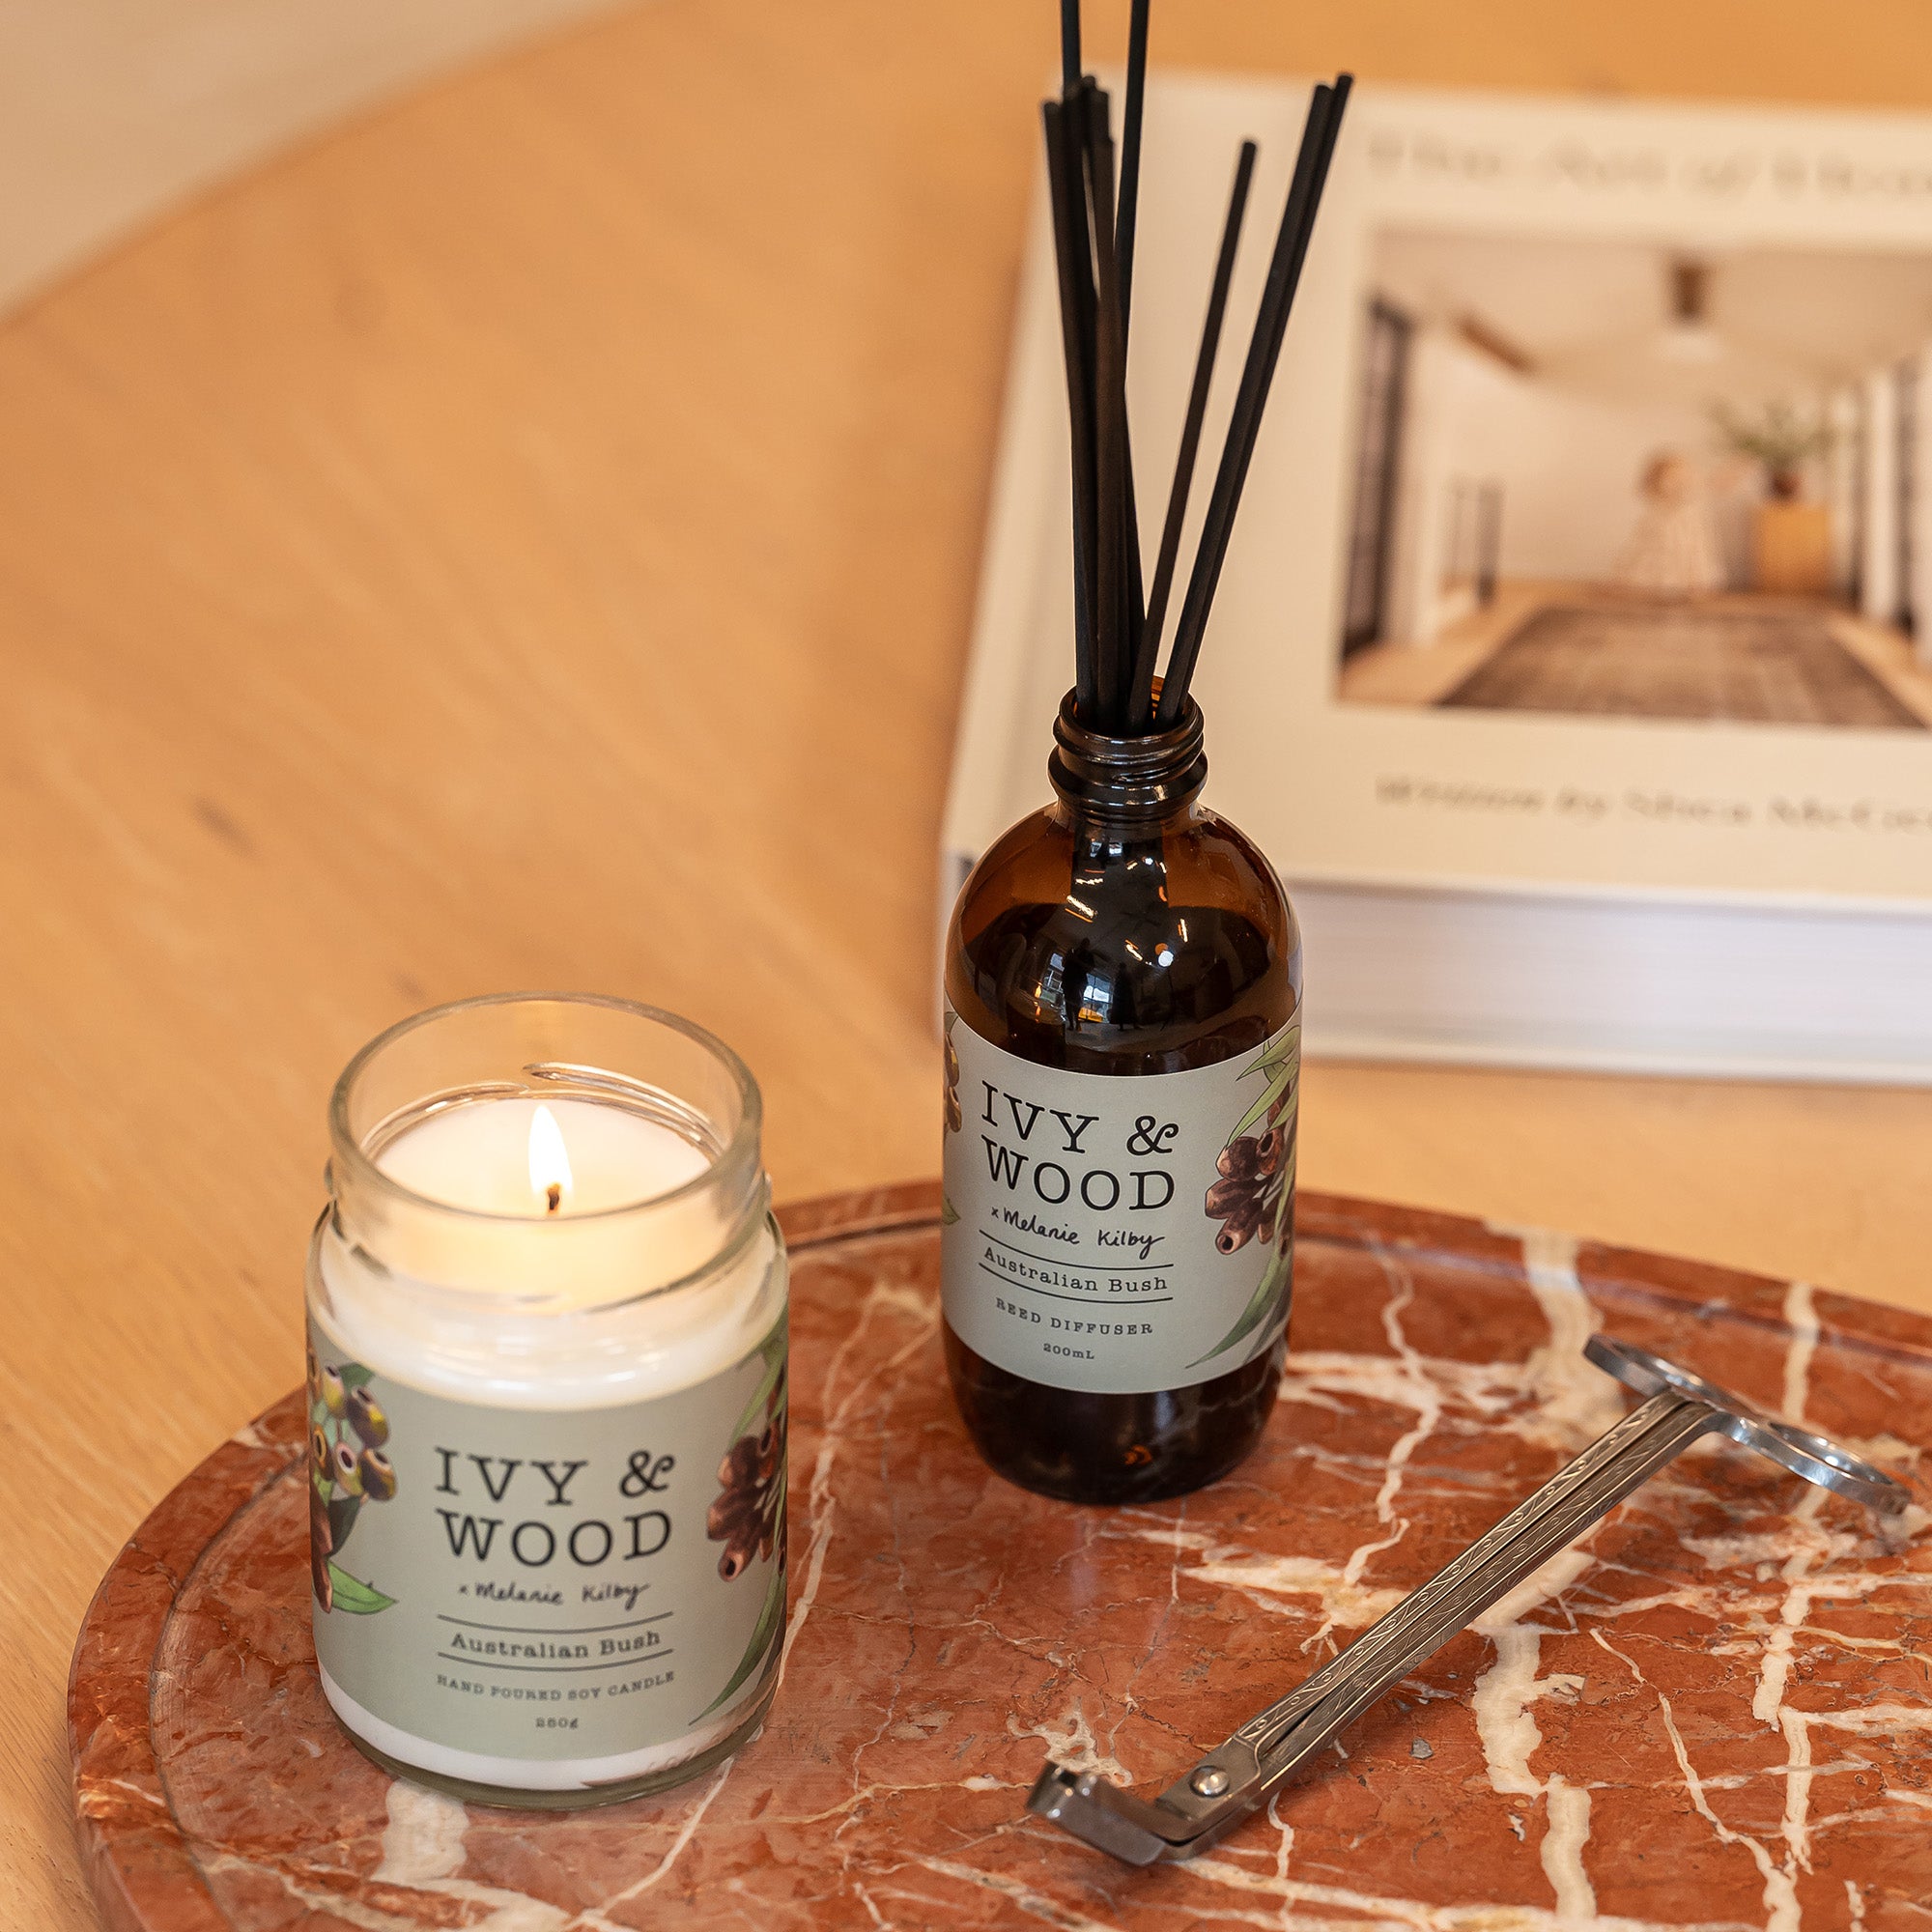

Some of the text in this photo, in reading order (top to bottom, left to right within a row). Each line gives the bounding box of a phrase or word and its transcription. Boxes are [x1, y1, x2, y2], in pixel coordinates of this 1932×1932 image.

[980, 1080, 1179, 1156] IVY &
[980, 1134, 1176, 1211] WOOD
[1003, 1208, 1080, 1245] Melanie
[1097, 1229, 1165, 1260] Kilby
[983, 1246, 1168, 1293] Australian Bush
[996, 1296, 1154, 1335] REED DIFFUSER
[1043, 1342, 1095, 1360] 200mL
[434, 1446, 675, 1506] IVY &
[434, 1507, 672, 1567] WOOD
[475, 1581, 564, 1605] Melanie
[582, 1583, 651, 1611] Kilby
[451, 1630, 661, 1659] Australian Bush
[437, 1671, 675, 1701] HAND POURED SOY CANDLE
